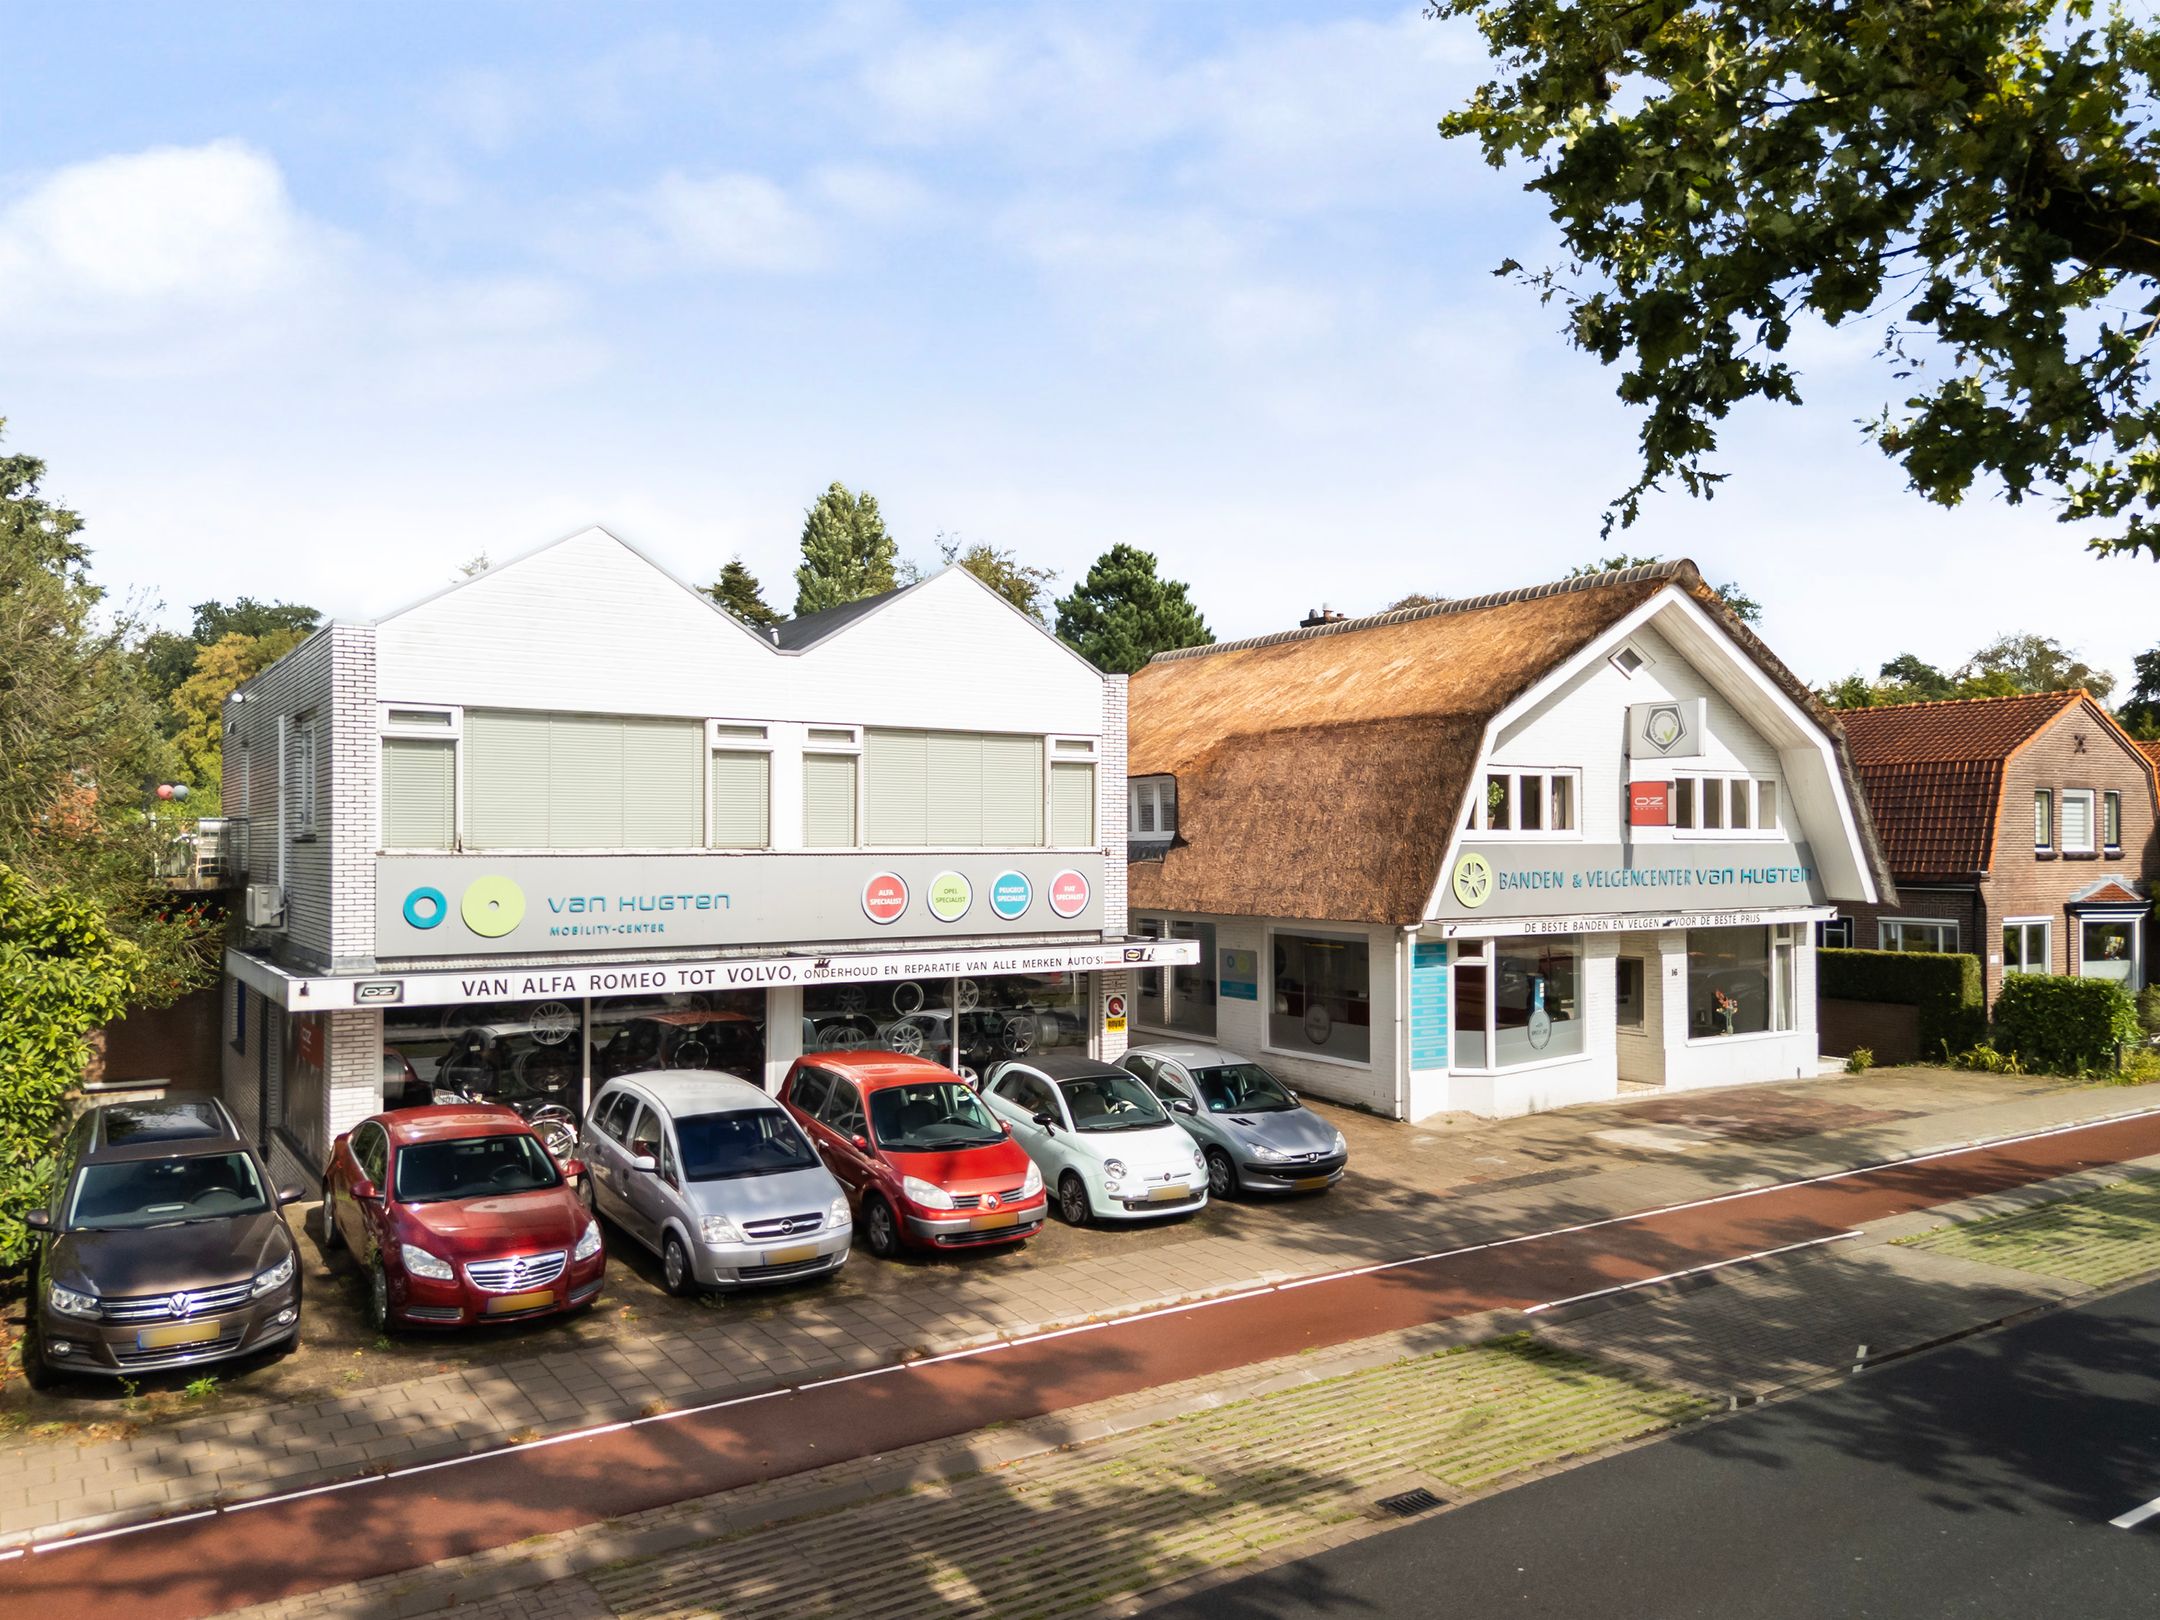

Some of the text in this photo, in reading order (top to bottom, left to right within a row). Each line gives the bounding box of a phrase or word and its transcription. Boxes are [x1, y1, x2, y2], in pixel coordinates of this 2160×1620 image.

[1635, 796, 1664, 806] OZ
[1499, 871, 1565, 890] BANDEN
[1572, 873, 1583, 888] &
[1586, 867, 1692, 887] VELGENCENTER
[550, 922, 665, 936] MOBILITY-CENTER
[1524, 913, 1761, 933] DE BESTE BANDEN EN VELGEN VOOR DE BESTE PRIJS
[461, 979, 508, 997] VAN
[522, 976, 576, 994] ALFA
[589, 972, 666, 991] ROMEO
[678, 969, 715, 985] TOT
[727, 965, 797, 983] VOLVO,
[804, 967, 878, 979] ONDERHOUD
[884, 966, 898, 975] EN
[904, 962, 960, 974] REPARATIE
[966, 961, 987, 971] VAN
[993, 960, 1017, 970] ALLE
[1022, 958, 1062, 968] MERKEN
[363, 988, 396, 996] OZ
